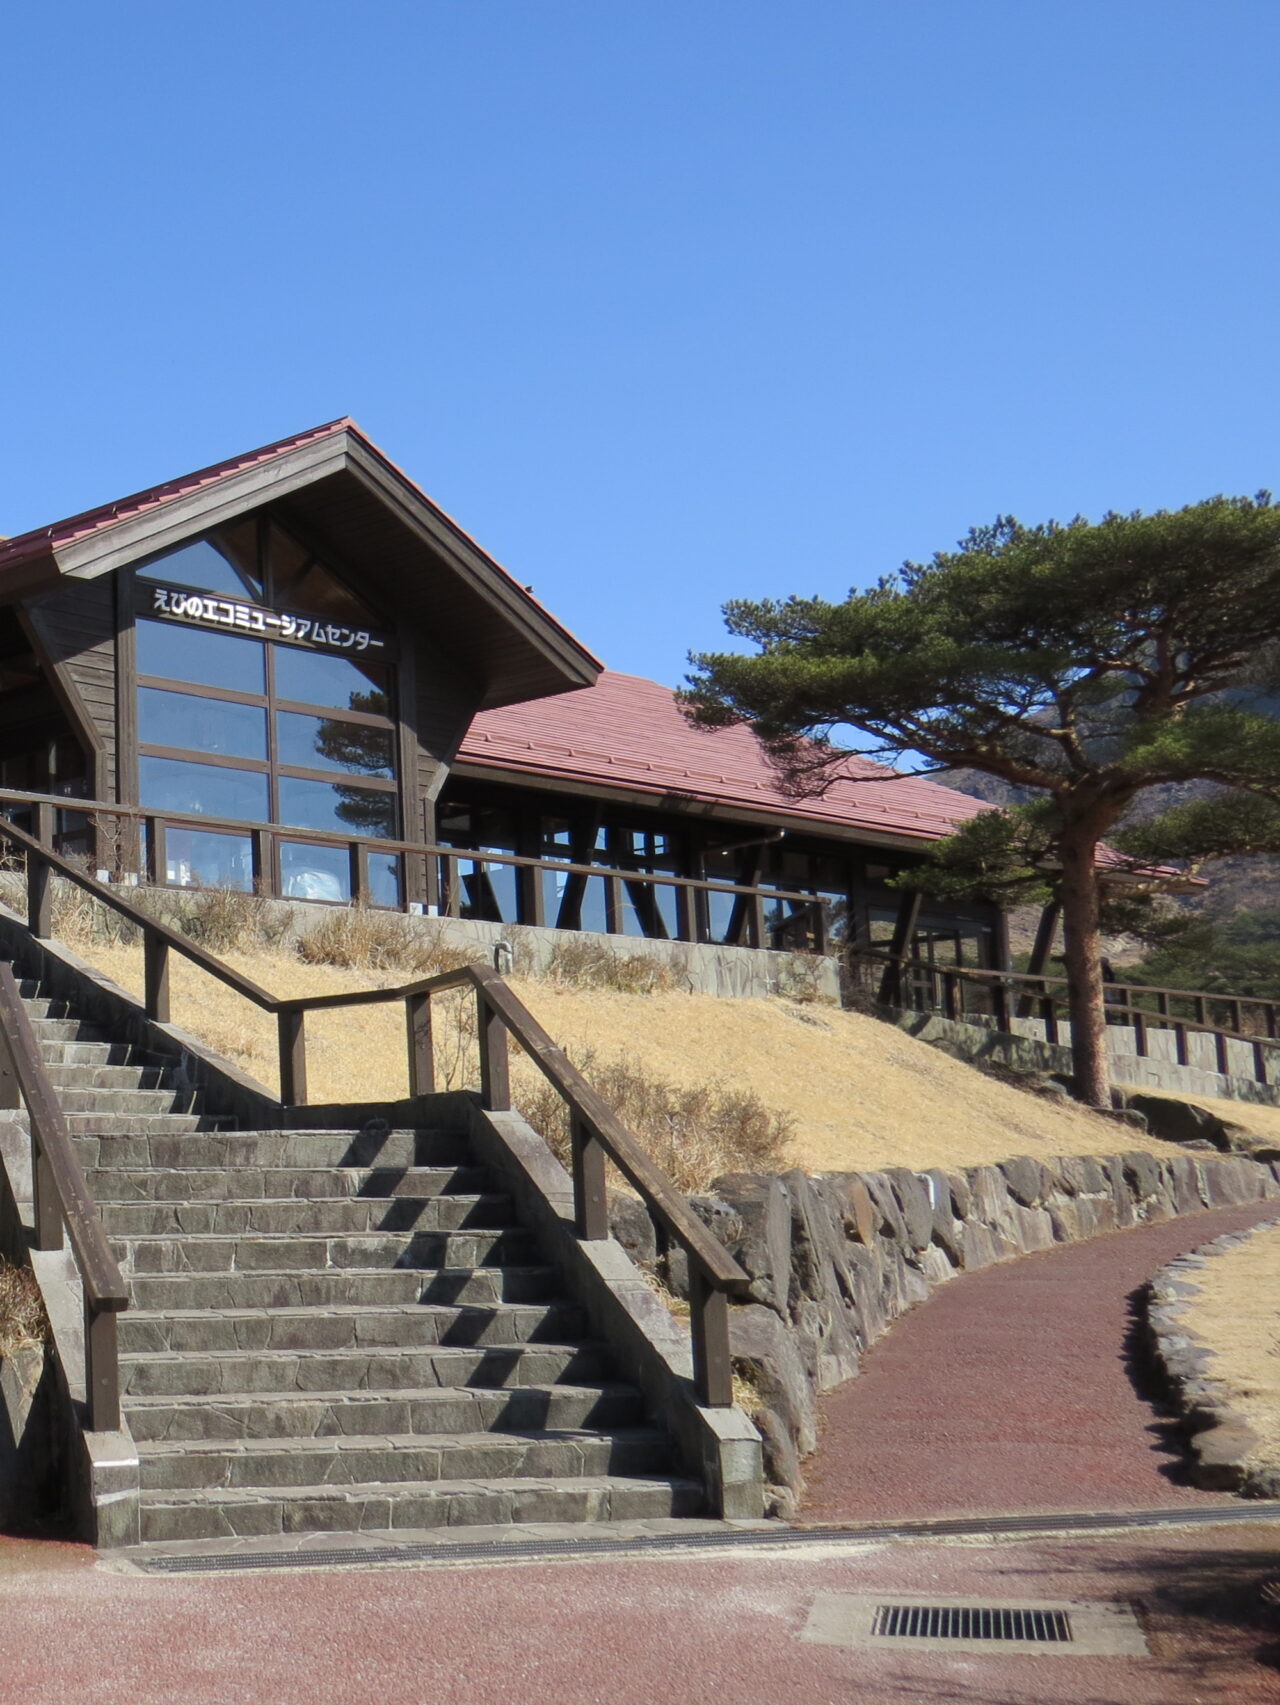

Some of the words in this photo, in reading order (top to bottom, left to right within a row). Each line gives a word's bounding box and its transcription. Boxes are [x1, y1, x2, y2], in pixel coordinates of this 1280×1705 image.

[154, 589, 384, 650] えびのエコミュージアムセンター
